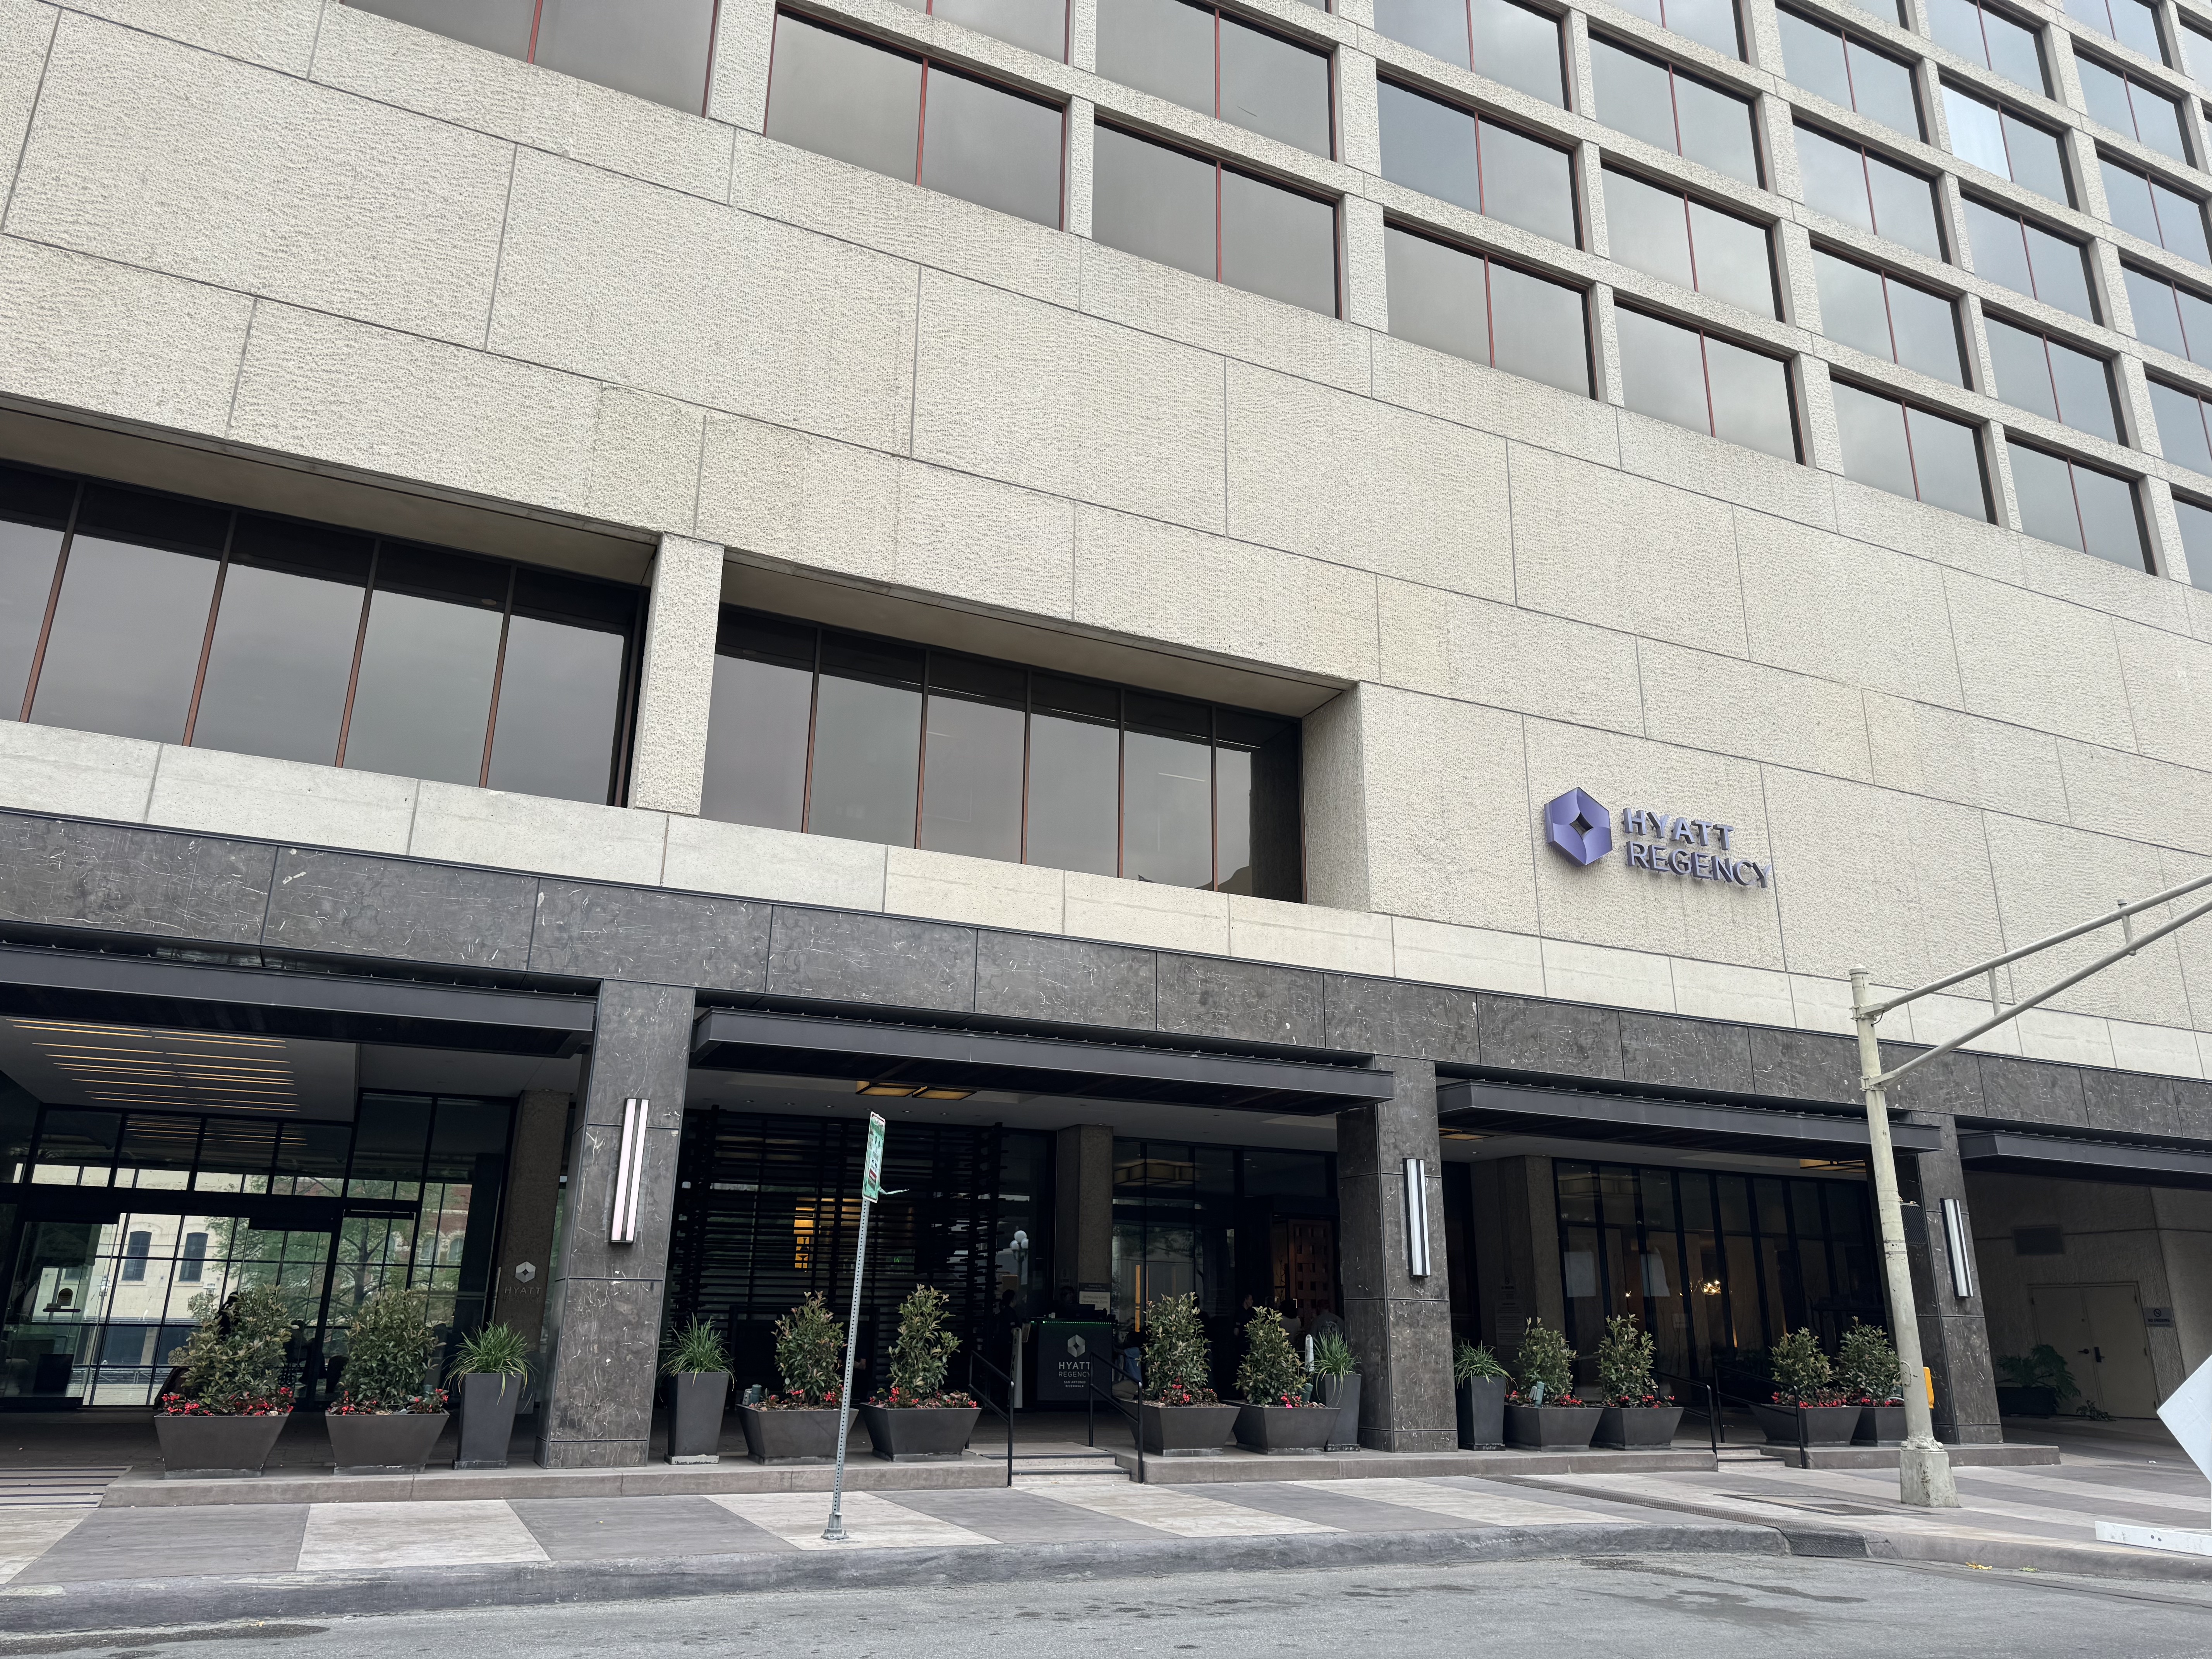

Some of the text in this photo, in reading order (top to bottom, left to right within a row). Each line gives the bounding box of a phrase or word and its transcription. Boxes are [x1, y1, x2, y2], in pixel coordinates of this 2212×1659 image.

[1623, 807, 1734, 850] HYATT
[1626, 840, 1772, 888] REGENCY
[1059, 1362, 1090, 1370] HYATT
